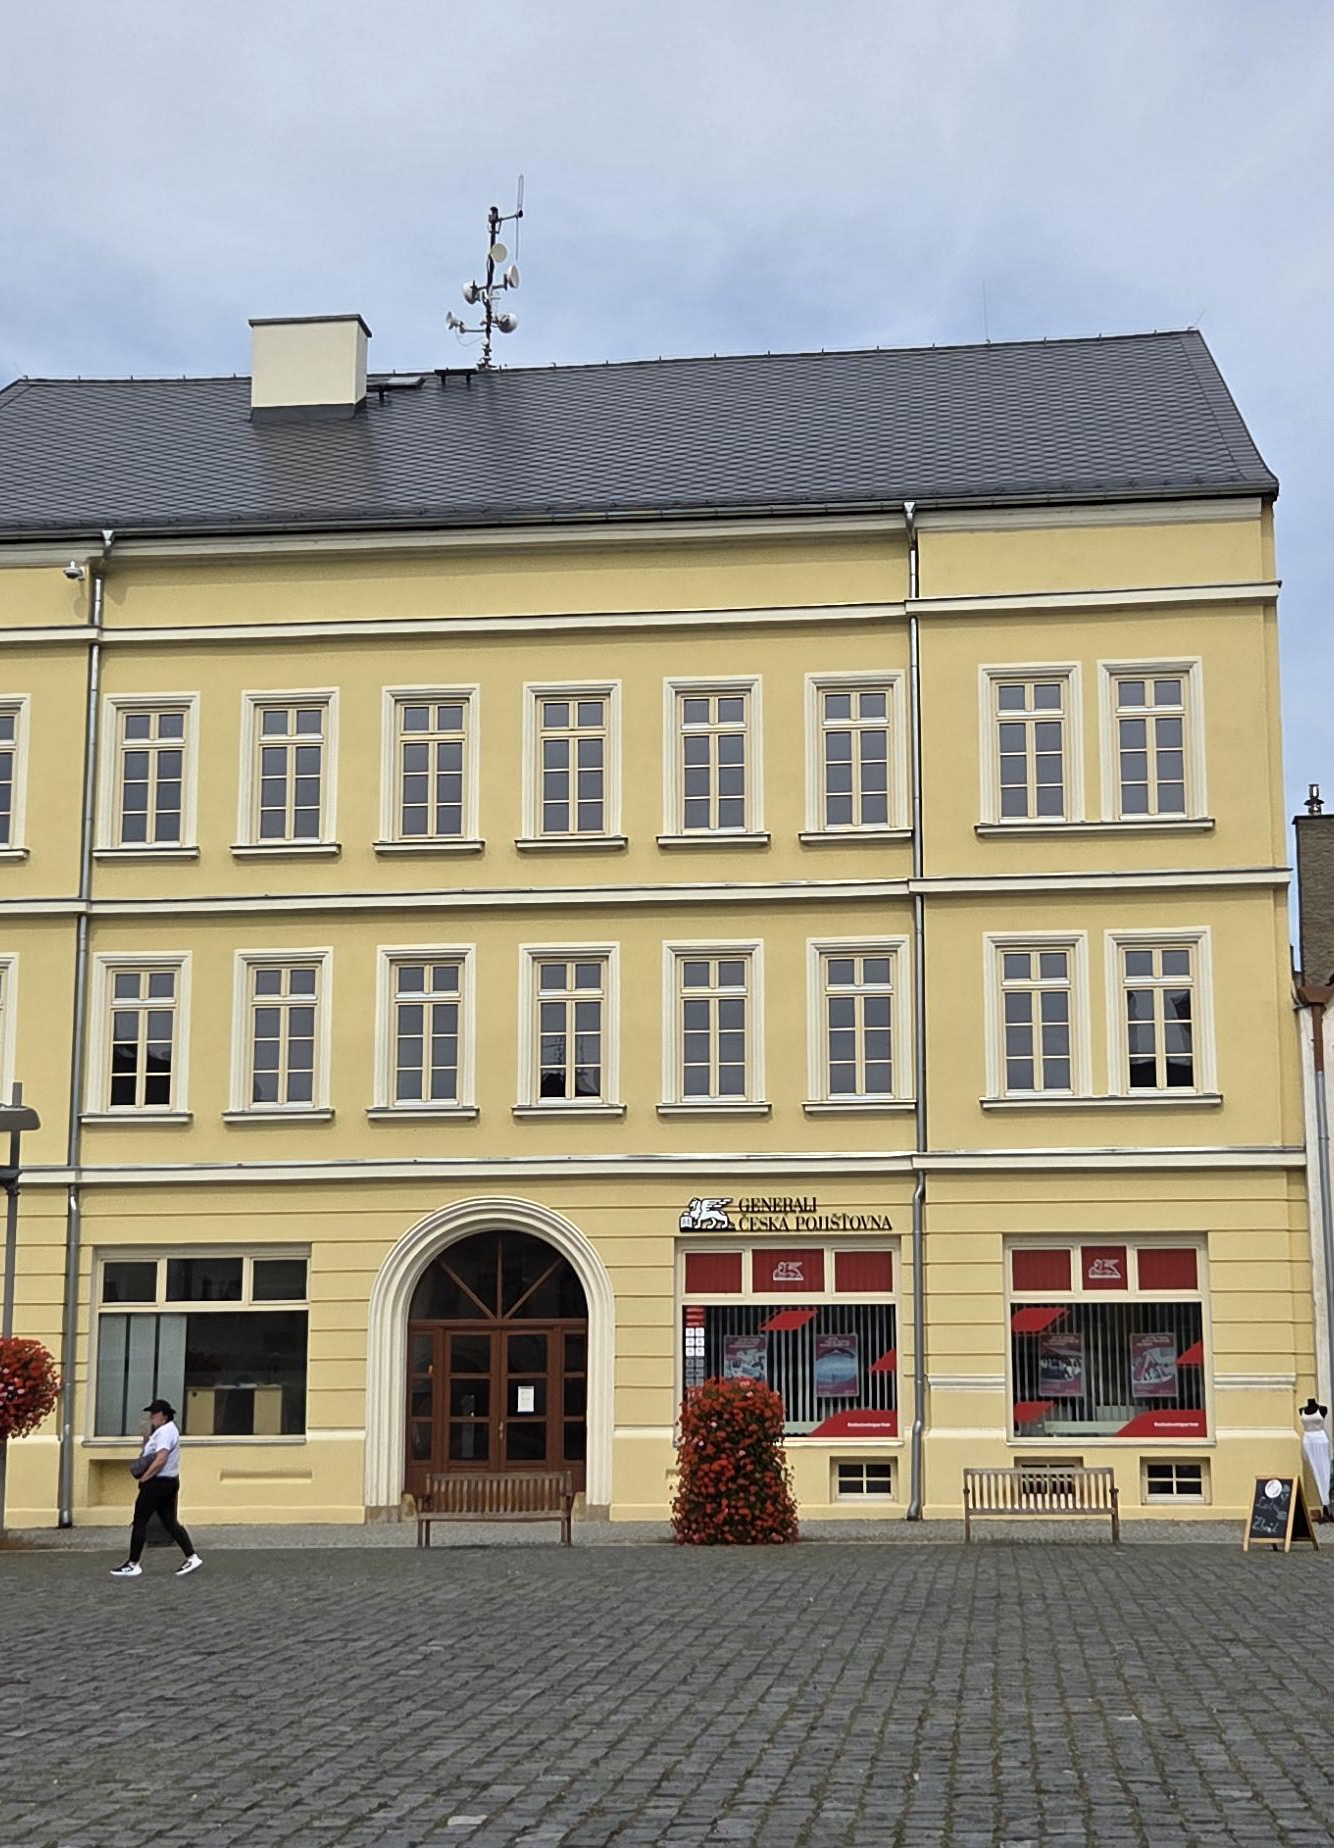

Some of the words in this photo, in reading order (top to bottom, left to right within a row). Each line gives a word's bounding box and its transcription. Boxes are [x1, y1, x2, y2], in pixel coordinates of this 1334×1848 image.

[738, 1197, 817, 1213] GENERALI
[738, 1212, 788, 1232] ČESKÁ
[795, 1213, 893, 1231] POJIŠŤOVNA
